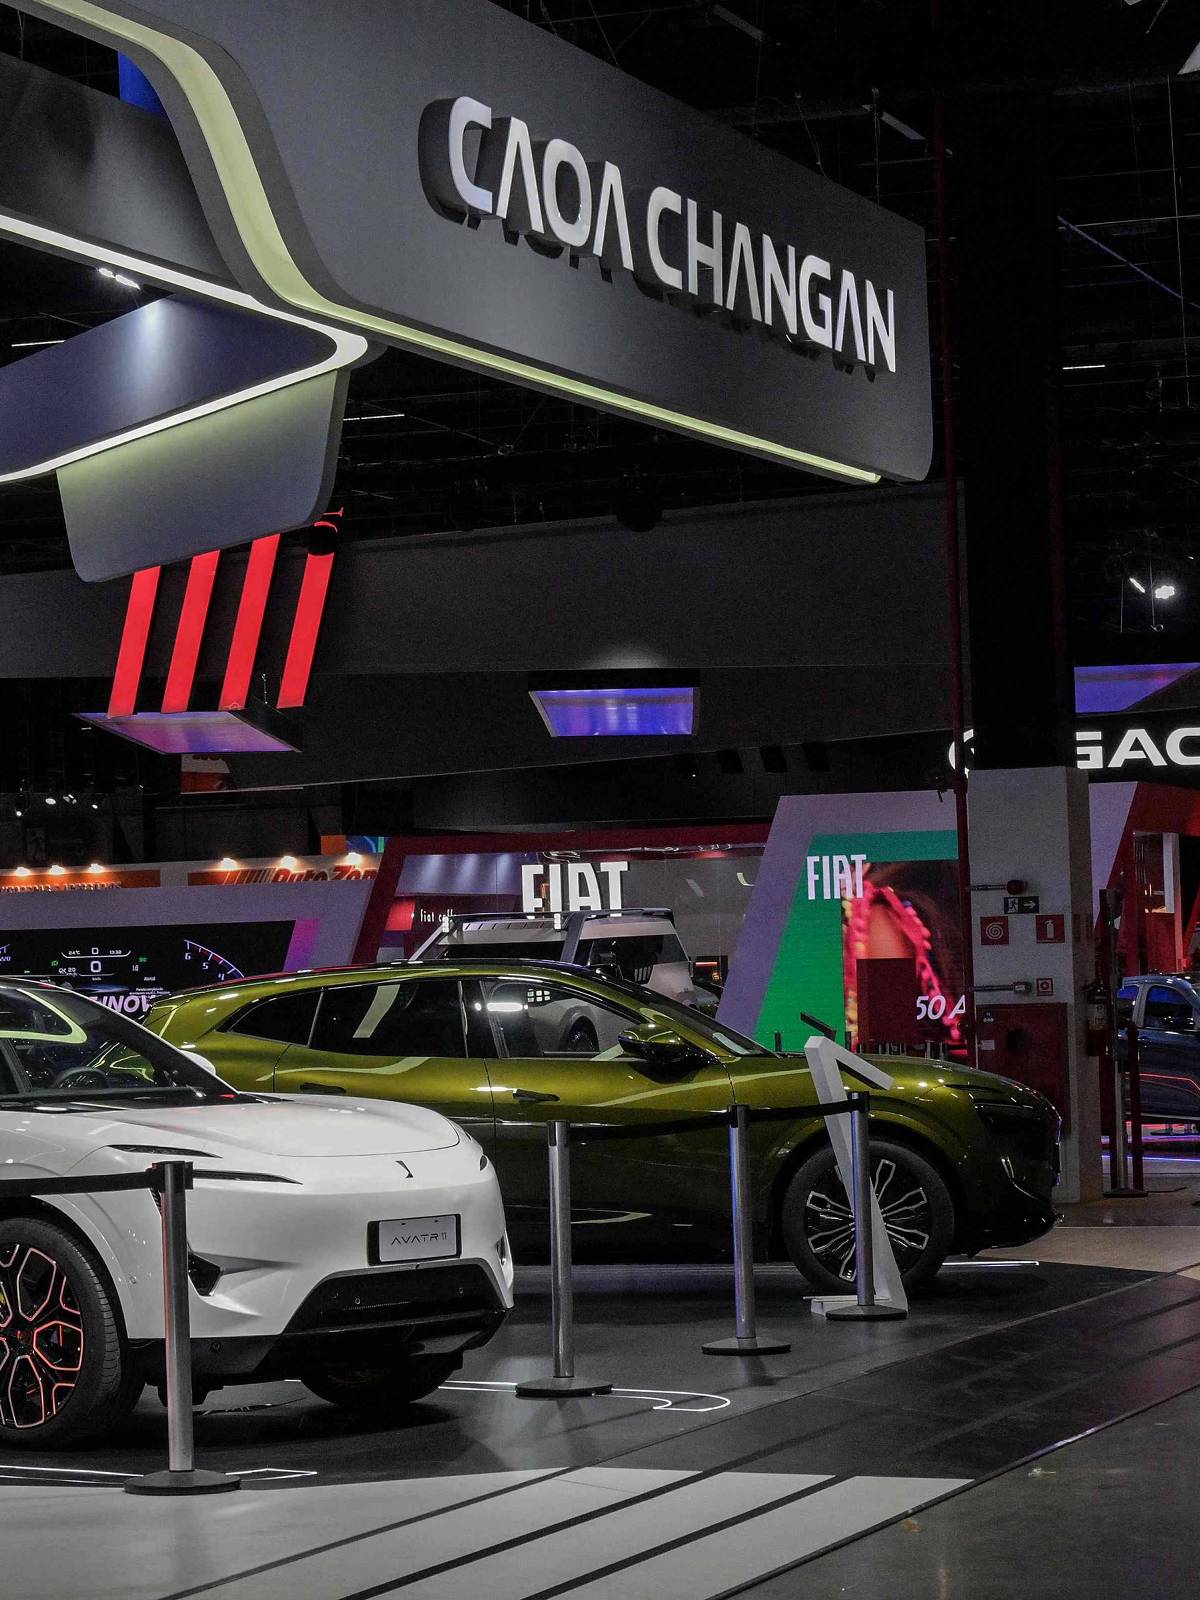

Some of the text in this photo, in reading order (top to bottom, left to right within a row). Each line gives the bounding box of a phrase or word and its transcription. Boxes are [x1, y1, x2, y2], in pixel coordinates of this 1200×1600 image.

[448, 96, 896, 373] CAOA CHANGAN
[521, 861, 628, 918] FIAT
[806, 854, 867, 900] FIAT
[420, 909, 435, 922] fiat
[916, 995, 946, 1020] 50
[391, 1233, 439, 1245] AVATR
